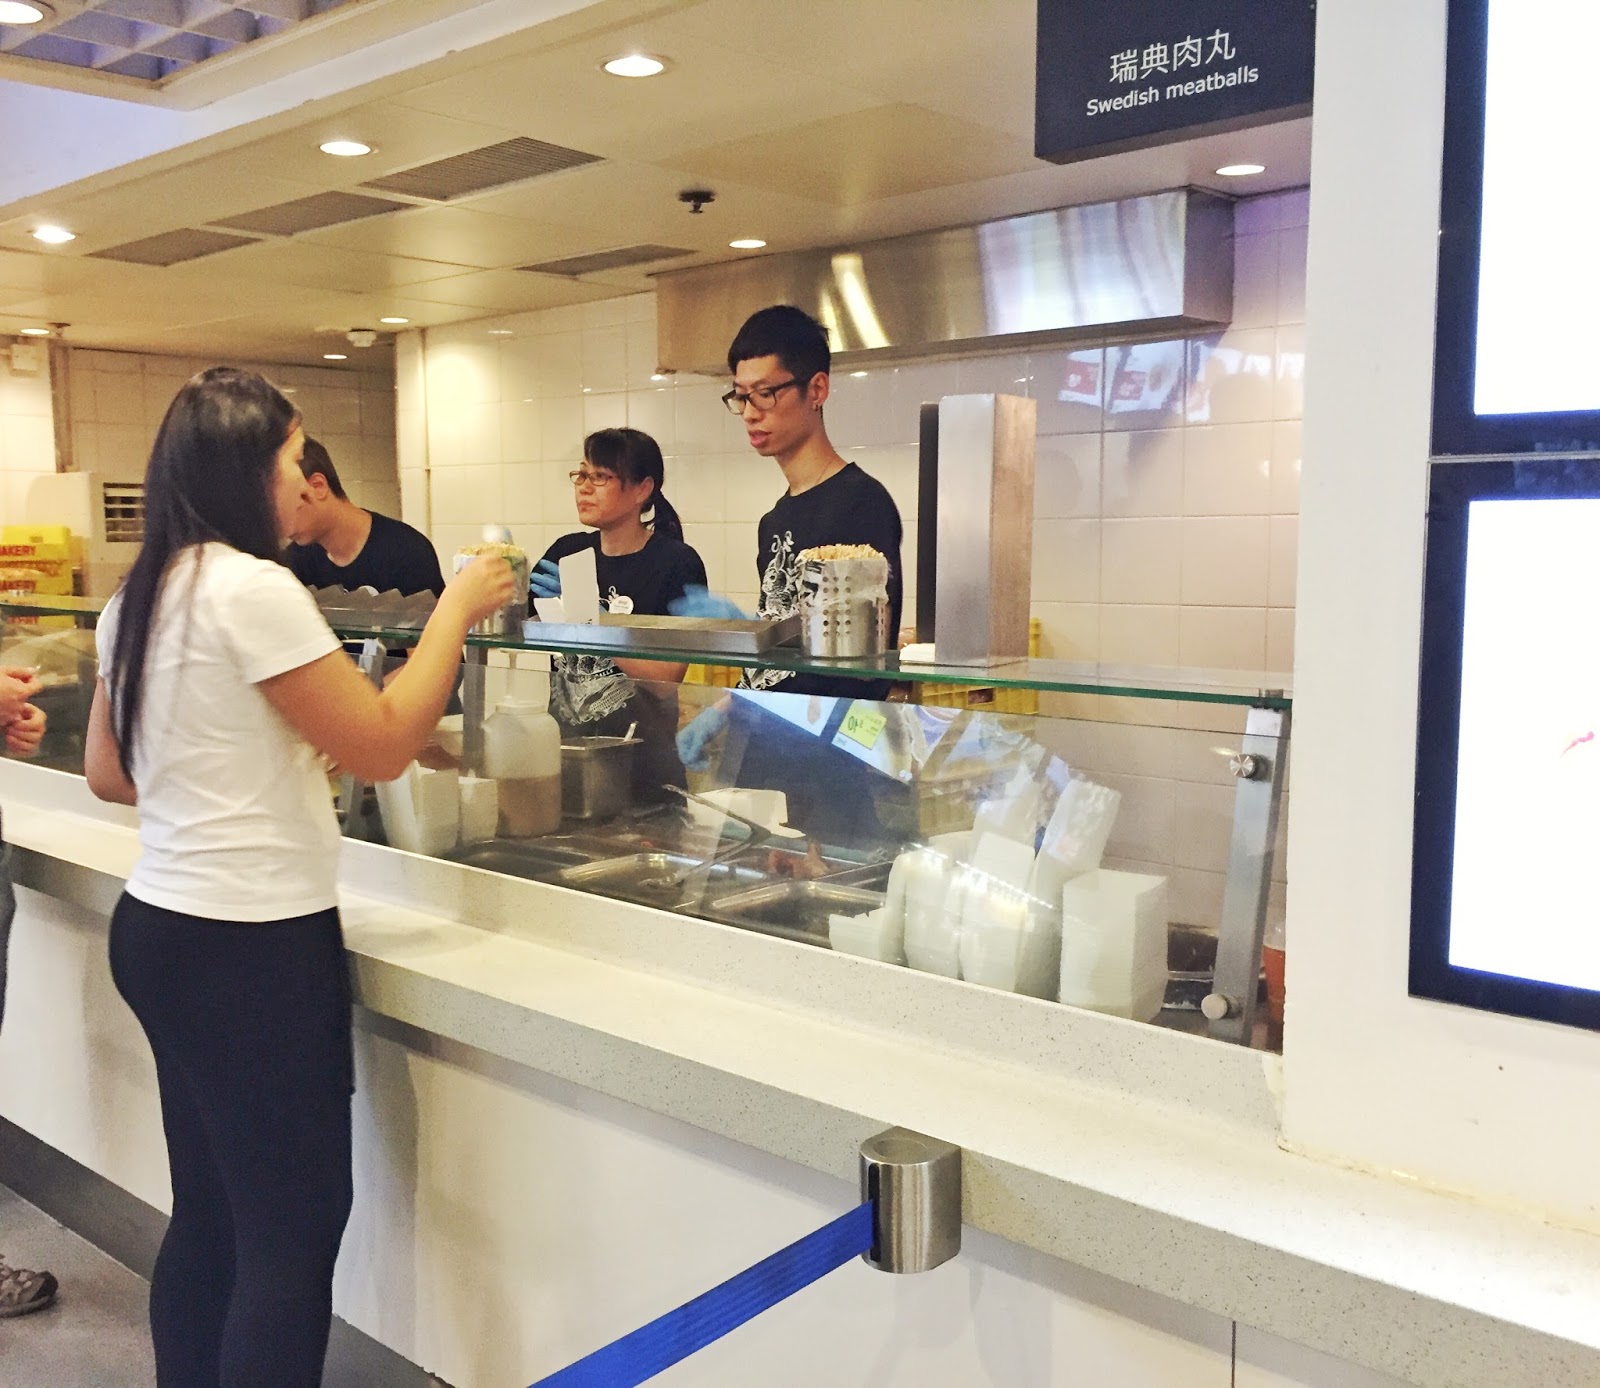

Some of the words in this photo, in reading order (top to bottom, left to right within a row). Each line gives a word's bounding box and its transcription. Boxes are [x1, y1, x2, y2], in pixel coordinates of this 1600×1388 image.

[1109, 28, 1236, 84] 瑞典肉丸
[1086, 86, 1160, 116] Swedish
[1166, 65, 1259, 100] meatballs
[0, 545, 36, 556] AKERY
